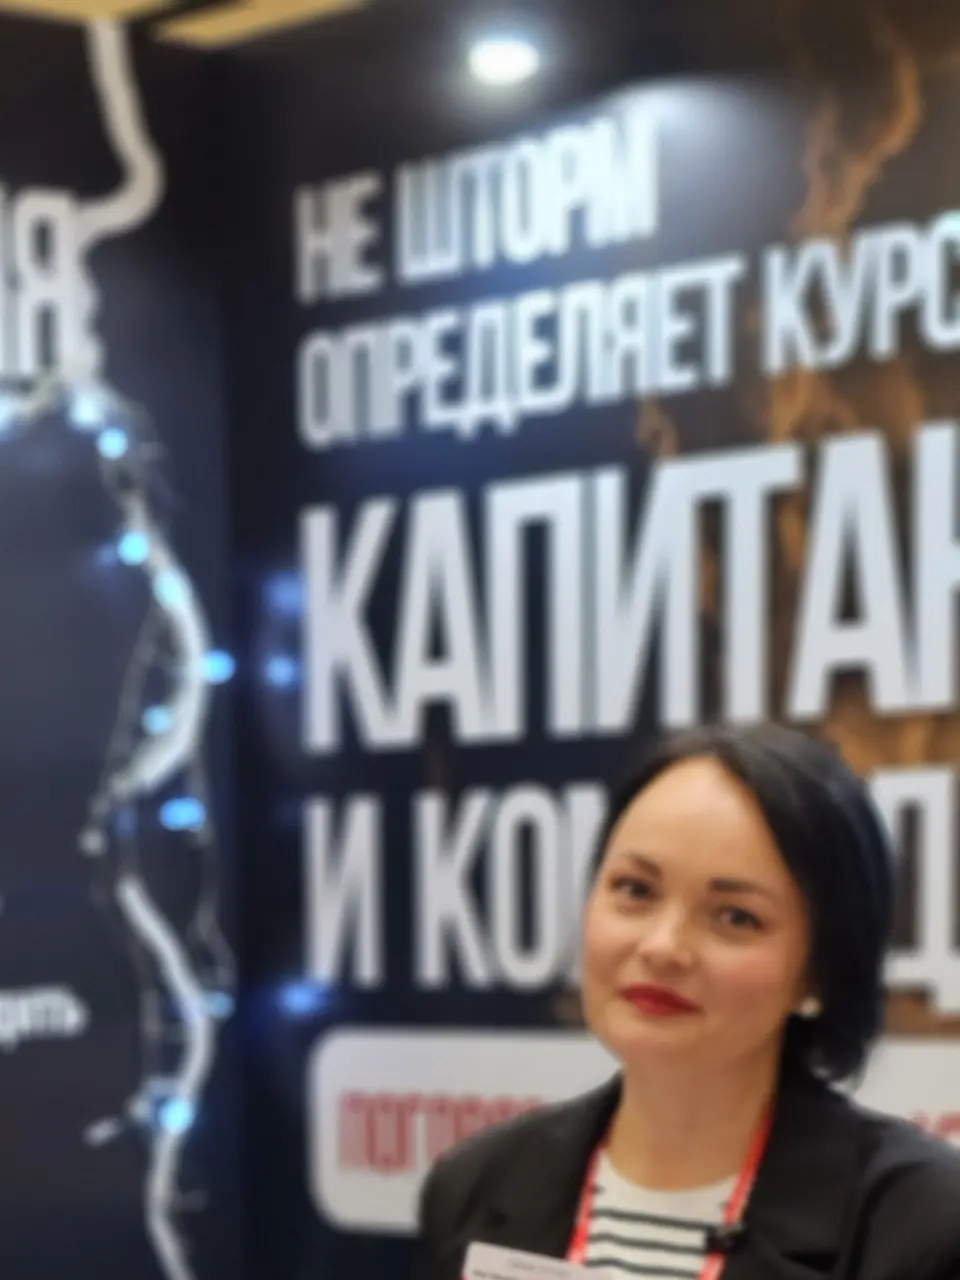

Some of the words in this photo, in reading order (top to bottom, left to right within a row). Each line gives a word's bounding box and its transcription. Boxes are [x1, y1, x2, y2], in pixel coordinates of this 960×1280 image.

[296, 173, 380, 302] НЕ
[298, 258, 743, 448] ОПРЕДЕЛЯЕТ
[304, 793, 383, 985] И
